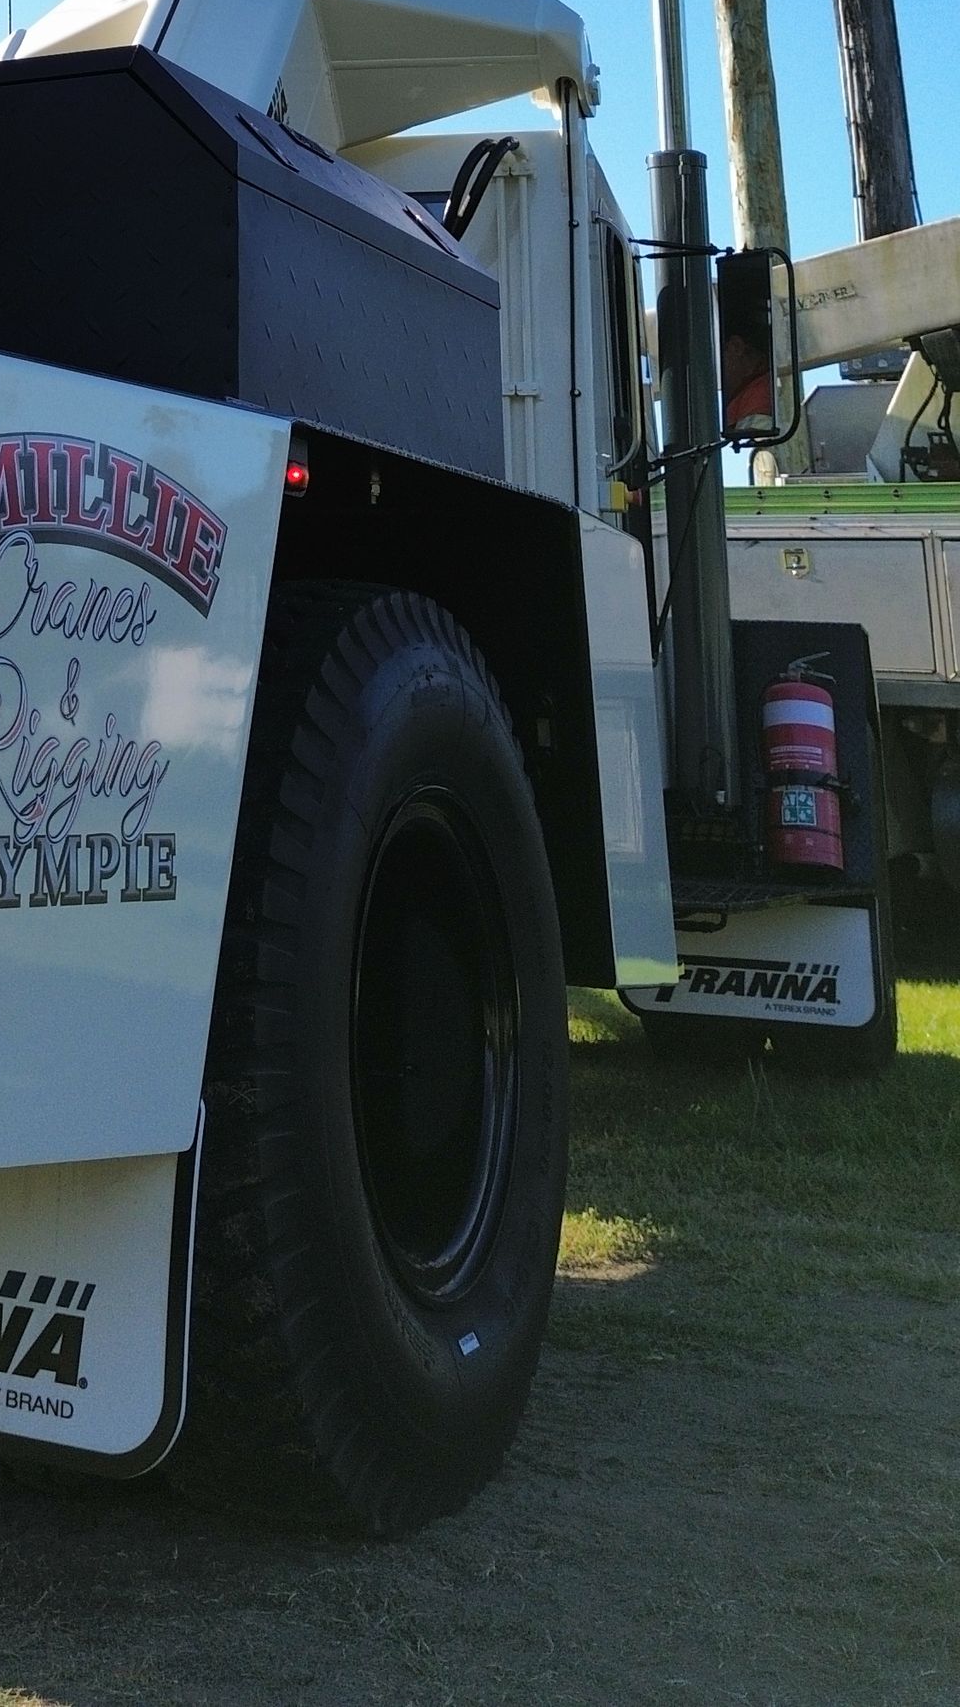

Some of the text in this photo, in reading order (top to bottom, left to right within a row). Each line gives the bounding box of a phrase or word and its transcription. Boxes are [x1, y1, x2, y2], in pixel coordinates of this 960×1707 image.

[60, 657, 80, 726] &
[764, 1002, 772, 1012] A
[773, 1004, 802, 1014] TEREX
[5, 1389, 74, 1419] BRAND
